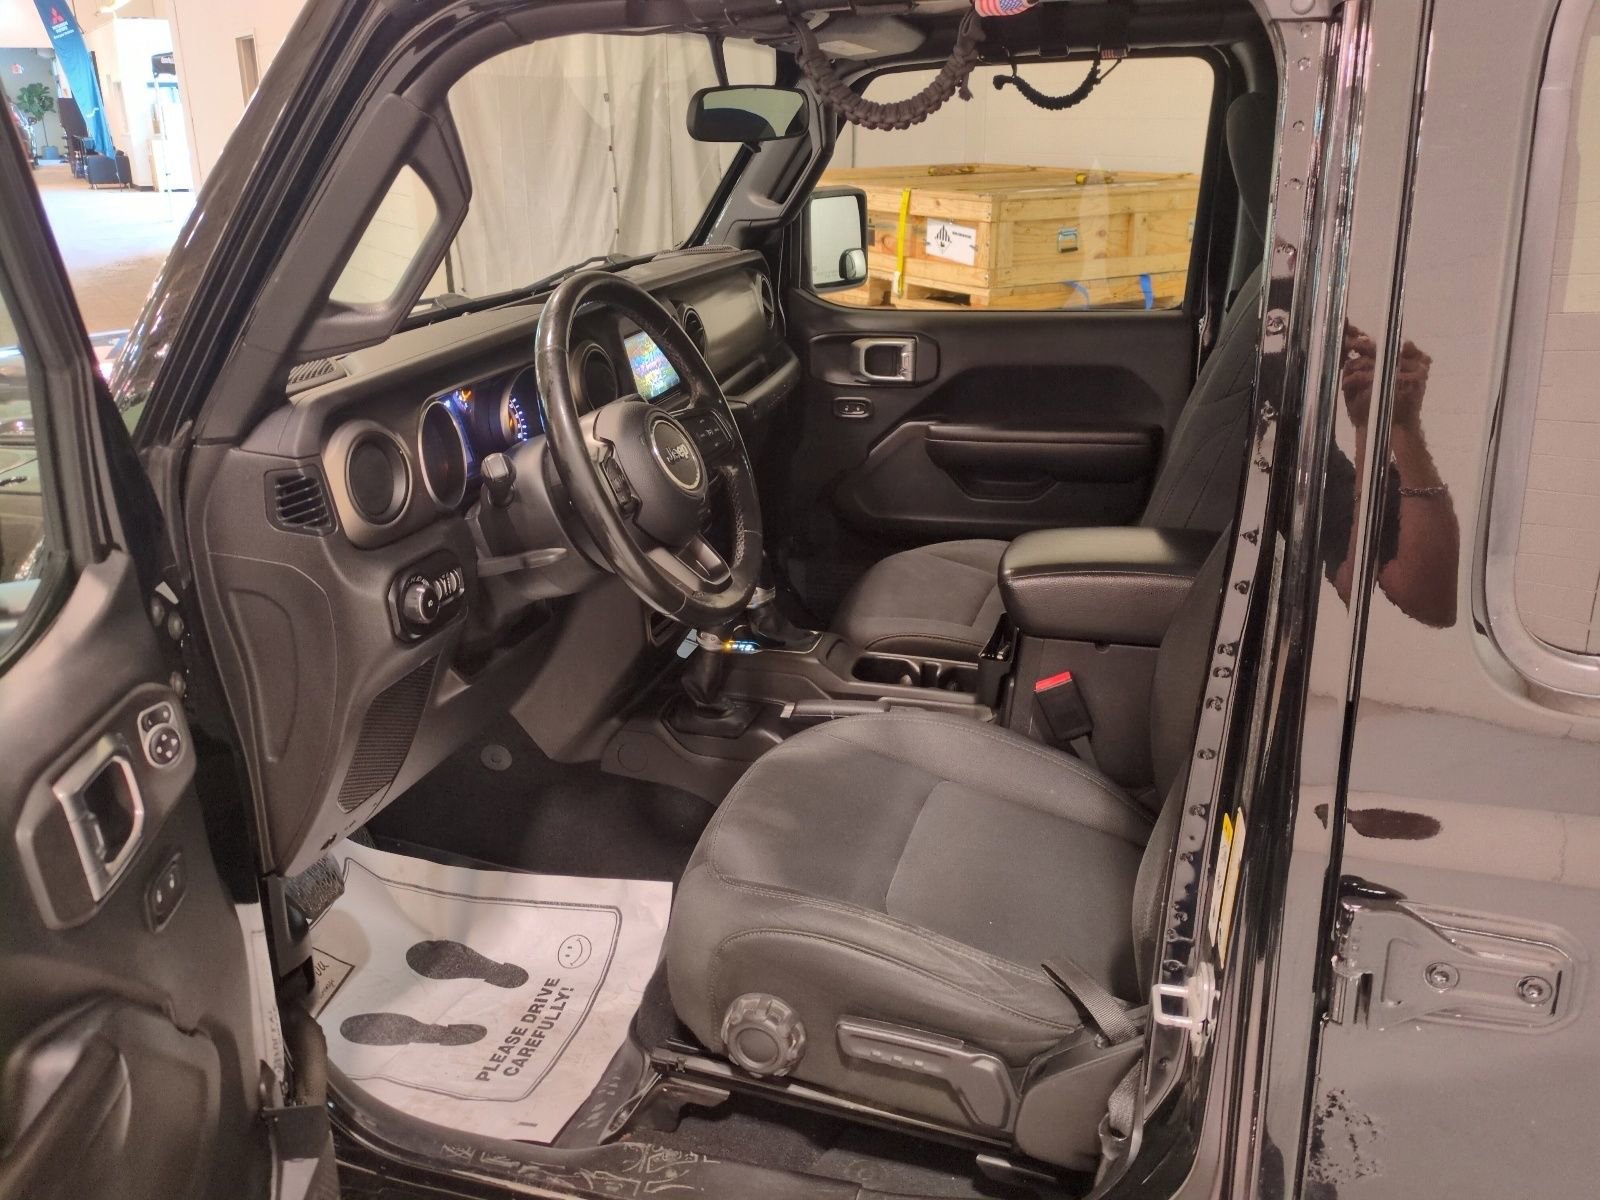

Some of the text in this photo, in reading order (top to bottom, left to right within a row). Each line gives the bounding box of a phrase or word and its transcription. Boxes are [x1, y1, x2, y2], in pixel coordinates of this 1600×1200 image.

[665, 444, 689, 463] Jeep
[475, 978, 560, 1082] PLEASE DRIVE
[503, 987, 574, 1077] CAREFULLY!
